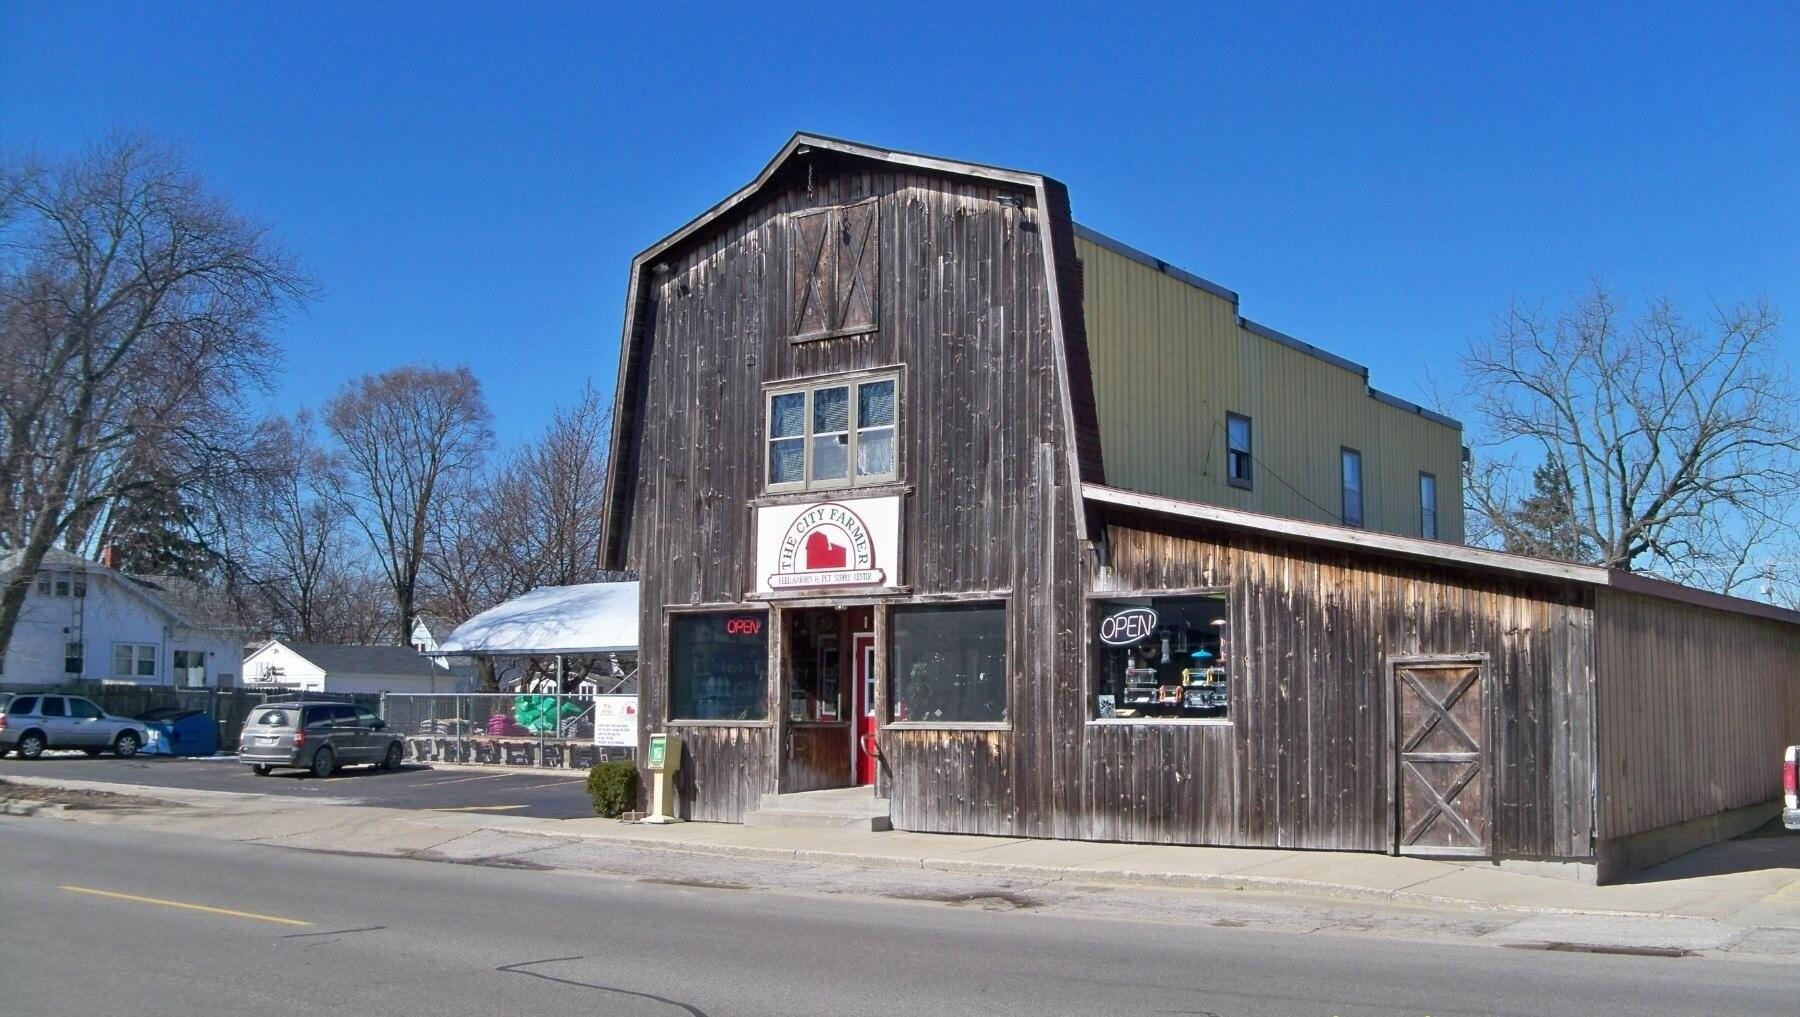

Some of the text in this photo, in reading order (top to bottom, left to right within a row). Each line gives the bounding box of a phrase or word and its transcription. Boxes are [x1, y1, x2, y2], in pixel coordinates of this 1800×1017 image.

[782, 508, 868, 570] THE CITY FARMER
[727, 619, 759, 634] OPEN
[1101, 614, 1152, 639] OPEN
